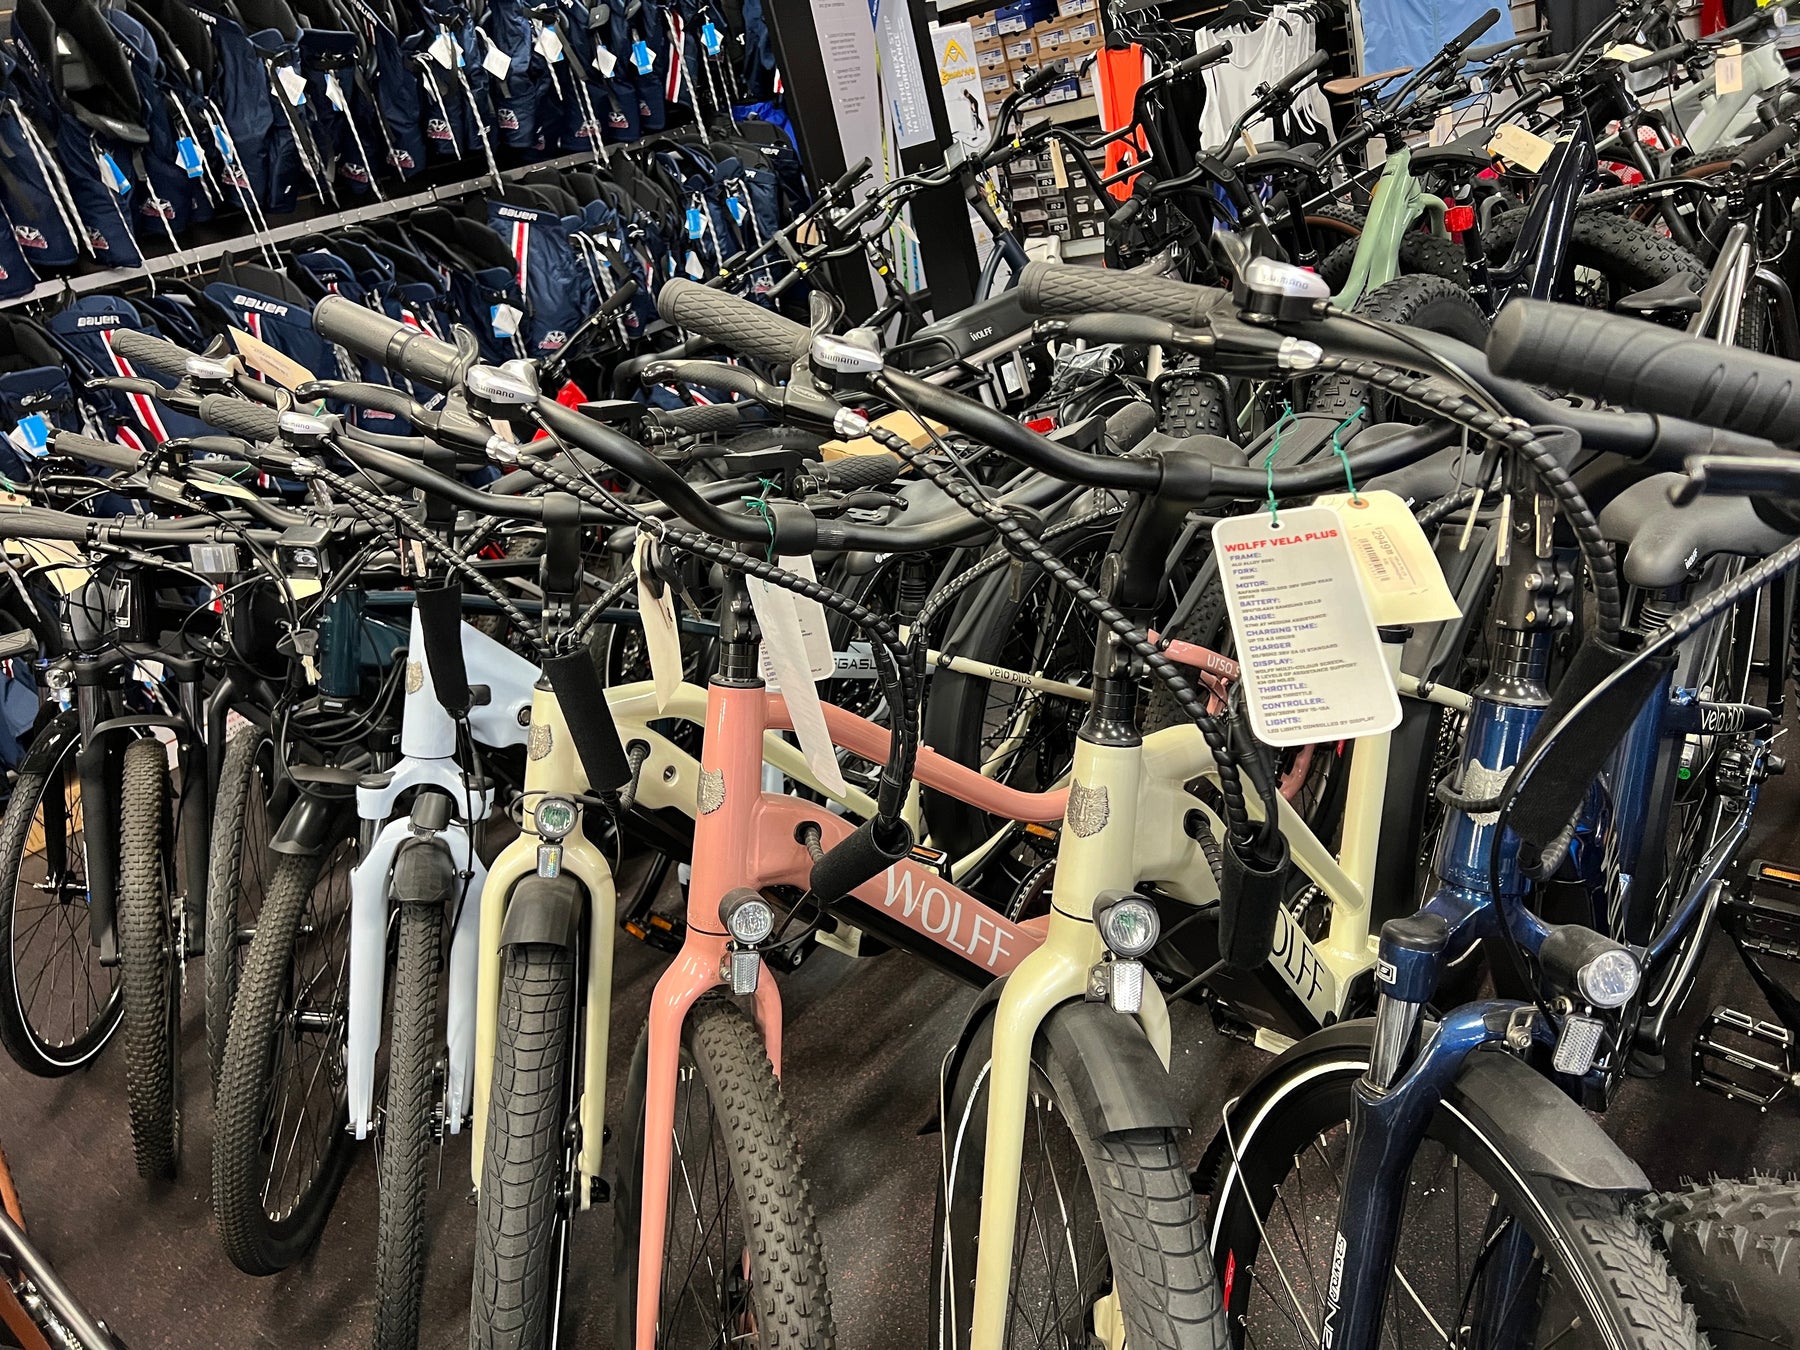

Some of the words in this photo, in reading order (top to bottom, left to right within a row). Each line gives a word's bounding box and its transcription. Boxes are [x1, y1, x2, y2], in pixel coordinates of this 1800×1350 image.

[883, 15, 893, 45] STEP
[891, 49, 902, 78] NEXT
[894, 32, 917, 118] PERFORMANCE
[898, 80, 907, 101] THE
[903, 105, 914, 134] TAKE
[498, 207, 538, 221] BAUER
[232, 294, 289, 317] BAUER
[77, 315, 121, 327] BAUER
[969, 326, 993, 341] WOLFF
[820, 352, 859, 366] SHIMANO
[475, 383, 515, 399] SHIMANO
[1225, 540, 1267, 552] WOLFF
[1270, 535, 1302, 546] VELA
[1305, 529, 1338, 540] PLUS
[1230, 552, 1261, 561] FRAME:
[1233, 567, 1257, 575] FORK:
[1236, 581, 1268, 589] MOTOR:
[1240, 598, 1281, 607] BATTERY:
[1243, 613, 1275, 622] RANGE:
[1246, 626, 1292, 637] CHARGING
[1294, 623, 1318, 631] TIME:
[1249, 642, 1291, 652] CHARGER
[1307, 643, 1338, 653] STANDARD
[1253, 658, 1293, 668] DISPLAY:
[1293, 668, 1328, 676] ASSISTANCE
[1330, 663, 1357, 671] SUPPORT
[1010, 671, 1032, 686] plus
[1258, 683, 1307, 693] THROTTLE:
[1262, 698, 1325, 710] CONTROLLER:
[1265, 717, 1301, 727] LIGHTS:
[1349, 716, 1375, 724] DISPLAY
[1725, 706, 1745, 732] 500
[883, 865, 1014, 967] WOLFF
